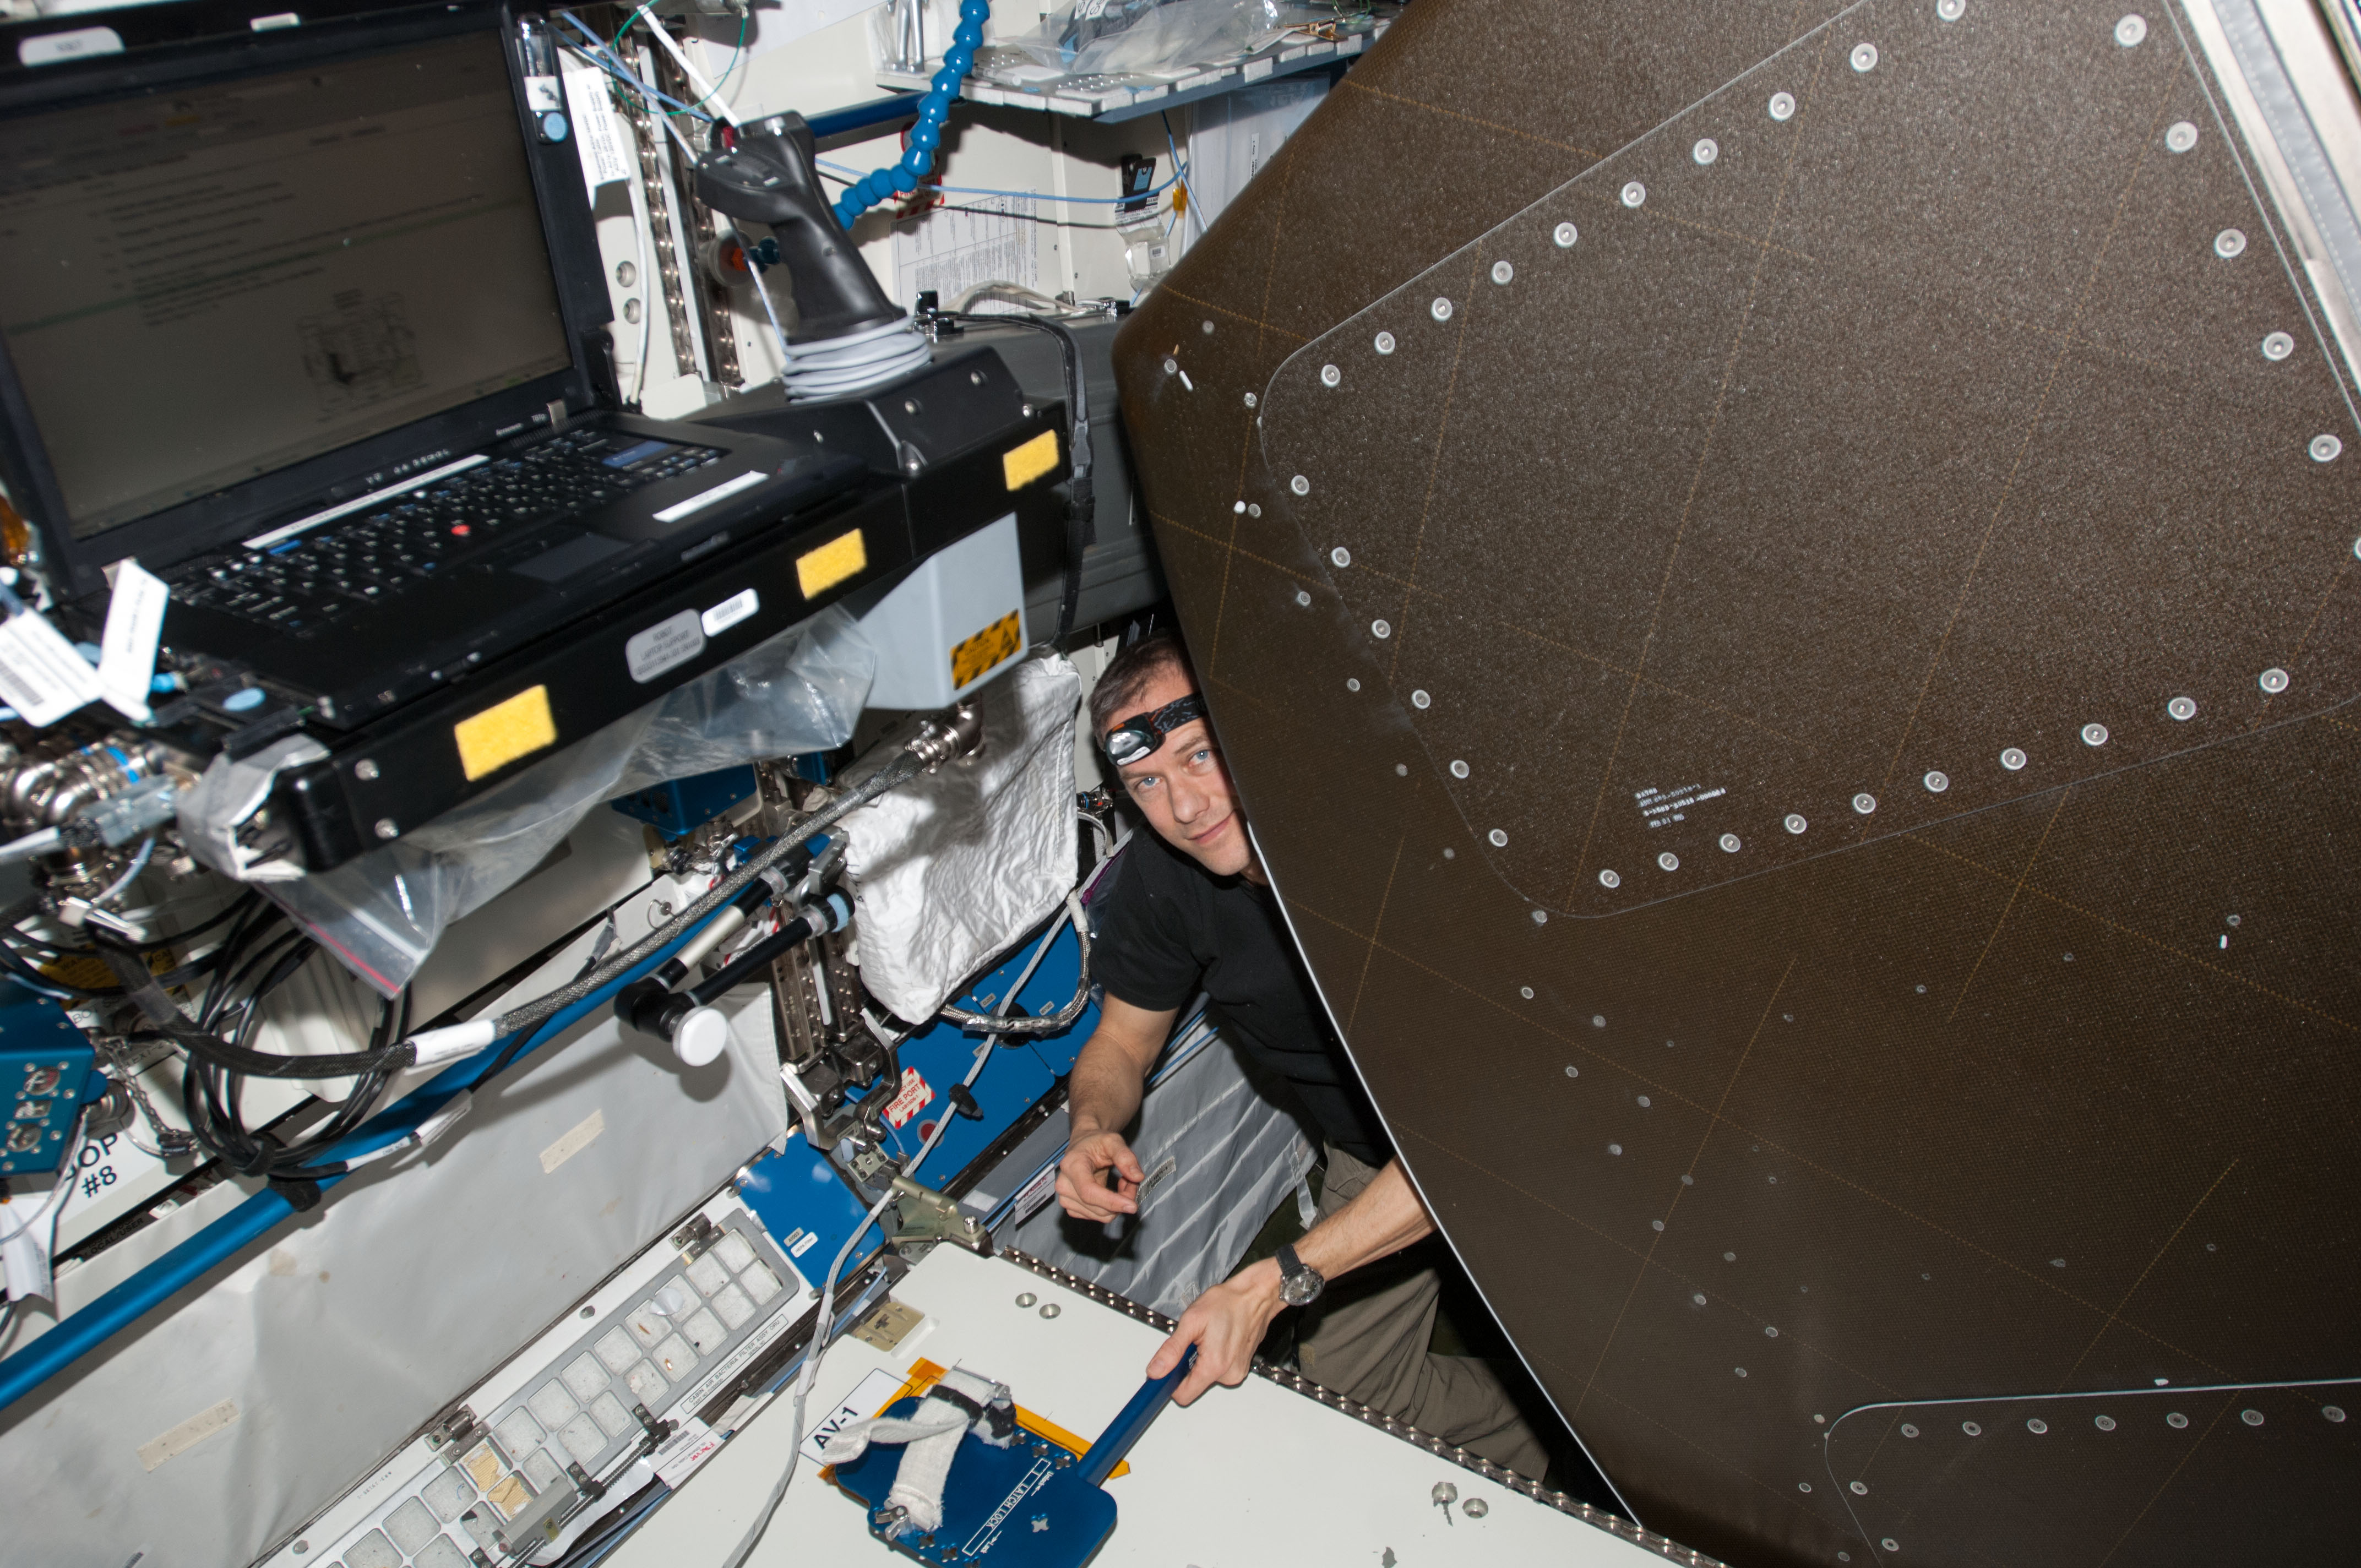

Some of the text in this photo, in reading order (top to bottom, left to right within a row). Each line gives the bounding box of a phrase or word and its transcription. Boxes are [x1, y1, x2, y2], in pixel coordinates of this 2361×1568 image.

[888, 1097, 904, 1112] FIRE
[902, 1083, 921, 1100] PORT
[79, 1163, 119, 1199] #8
[688, 1320, 780, 1403] CABIN AIR BACTERIA FILTER ASSY ORU
[813, 1406, 858, 1450] AV-1
[1037, 1469, 1054, 1487] Unlock
[985, 1482, 1029, 1530] LATCH LOCK
[980, 1540, 994, 1554] Lock
